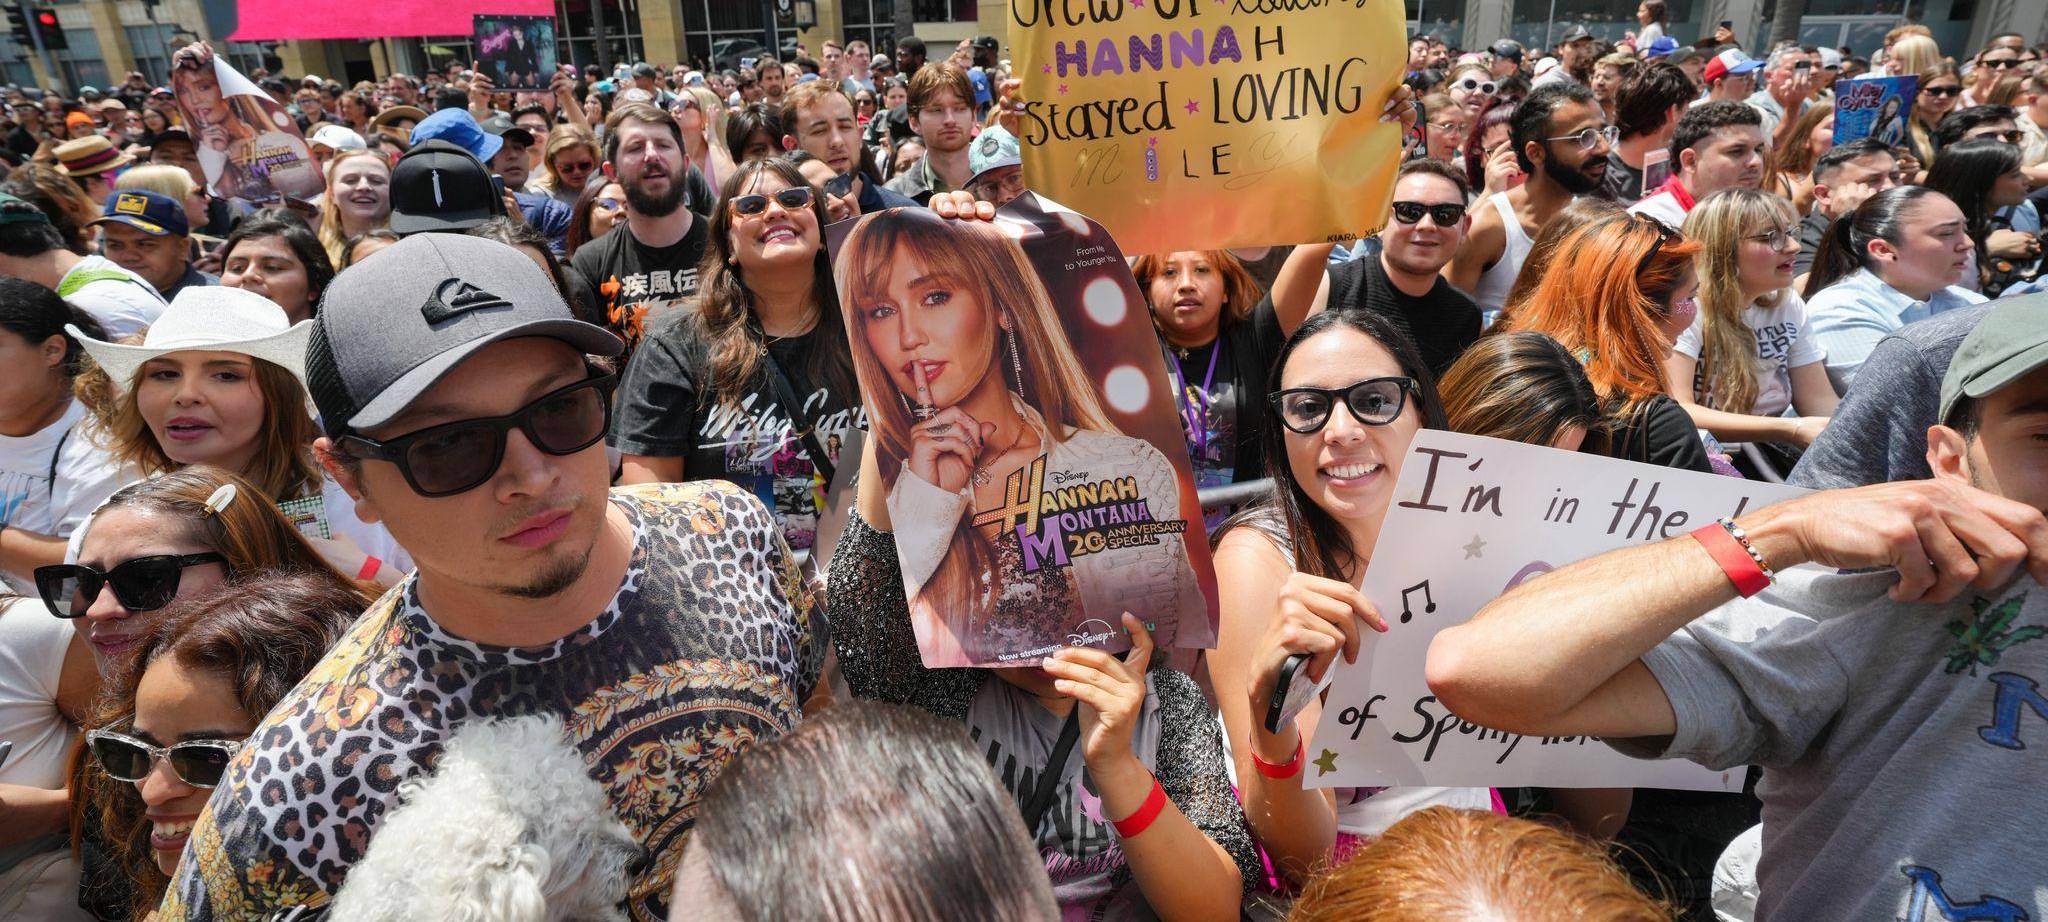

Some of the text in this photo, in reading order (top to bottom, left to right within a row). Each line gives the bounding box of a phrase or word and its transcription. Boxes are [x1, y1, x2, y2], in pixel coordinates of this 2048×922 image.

[1055, 25, 1285, 78] HANNAH
[1024, 57, 1367, 147] Stayed LOVING
[1064, 263, 1075, 271] to
[1076, 257, 1106, 268] Younger
[1076, 245, 1106, 257] From Me
[621, 267, 698, 297] 疾風伝
[1755, 322, 1798, 340] YRUS
[971, 453, 1138, 538] HANNAH
[1398, 446, 1689, 541] I'm in the
[1016, 501, 1151, 572] MONTANA
[1107, 521, 1186, 539] ANNIVERSARY
[1109, 533, 1158, 549] SPECIAL
[998, 652, 1019, 662] Now
[1337, 694, 1387, 741] of
